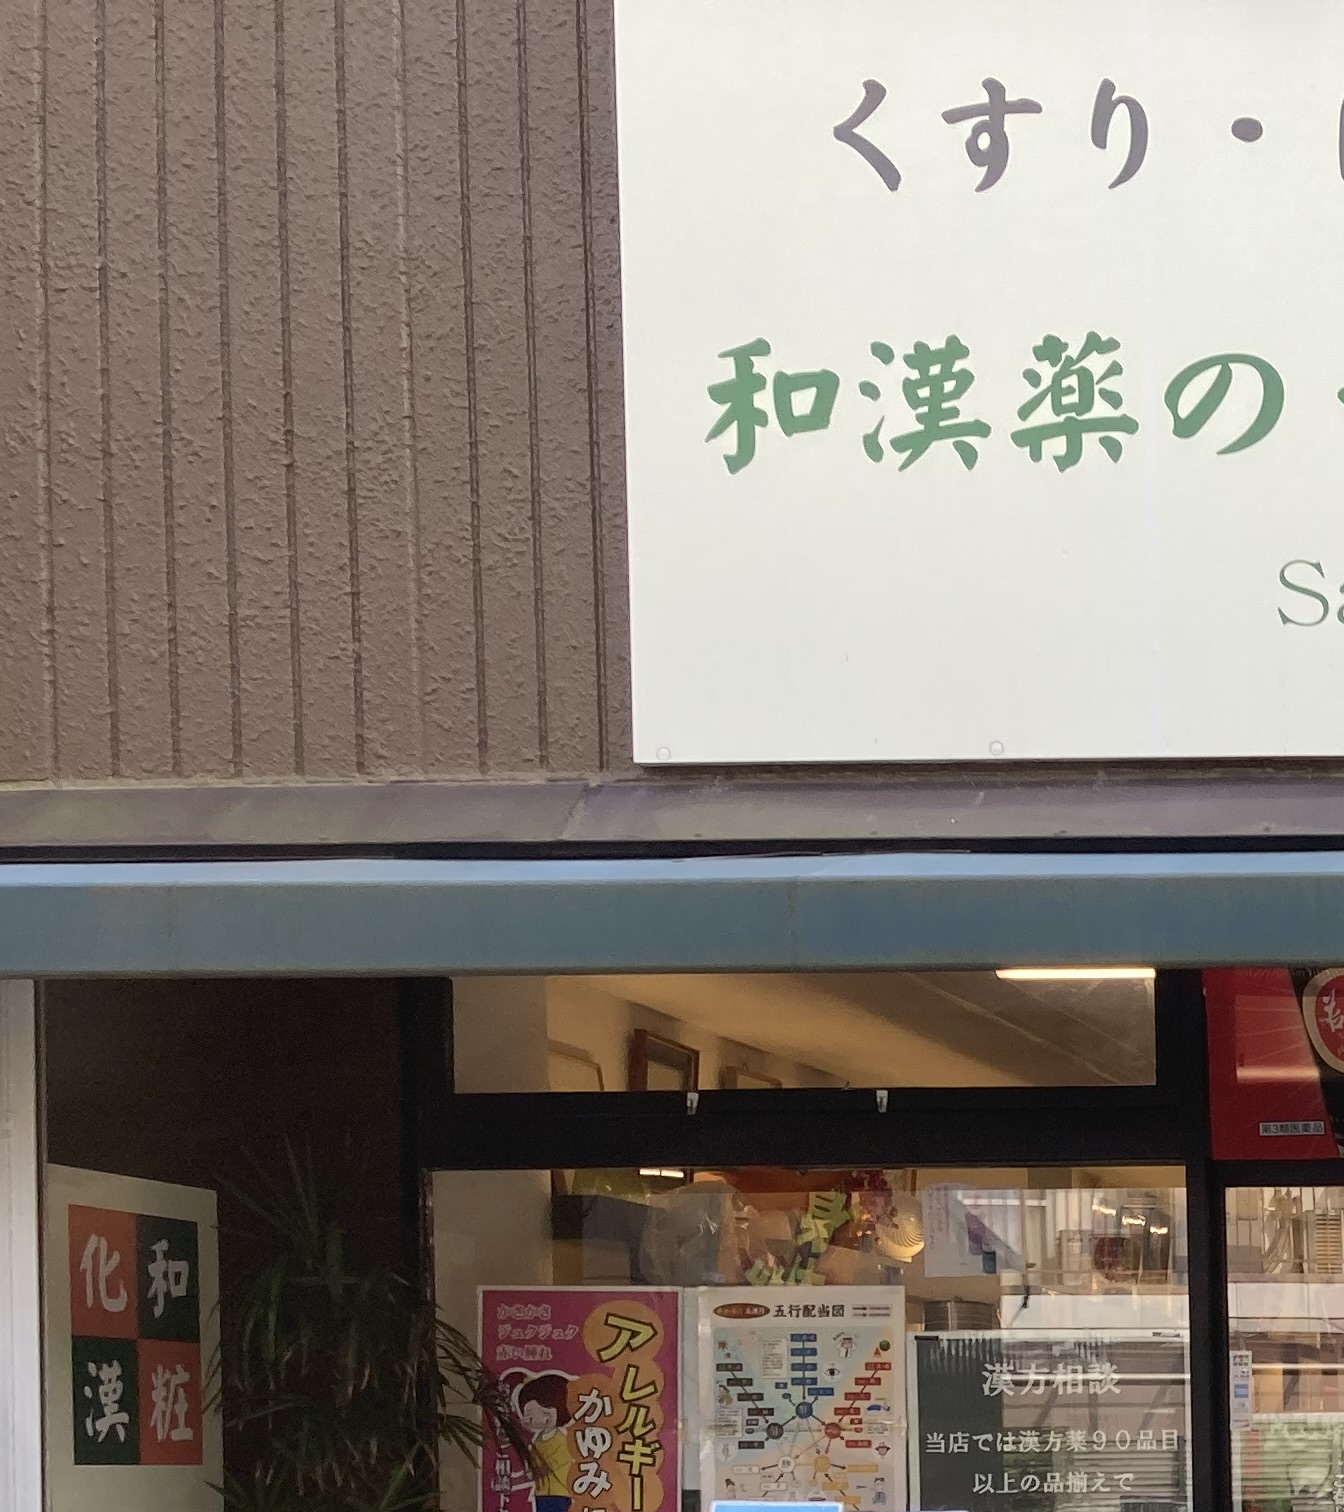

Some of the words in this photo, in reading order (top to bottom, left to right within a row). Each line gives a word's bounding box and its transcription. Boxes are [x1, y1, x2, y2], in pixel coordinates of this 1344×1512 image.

[596, 1311, 660, 1512] アレルギー
[982, 1363, 1121, 1397] 漢方相談
